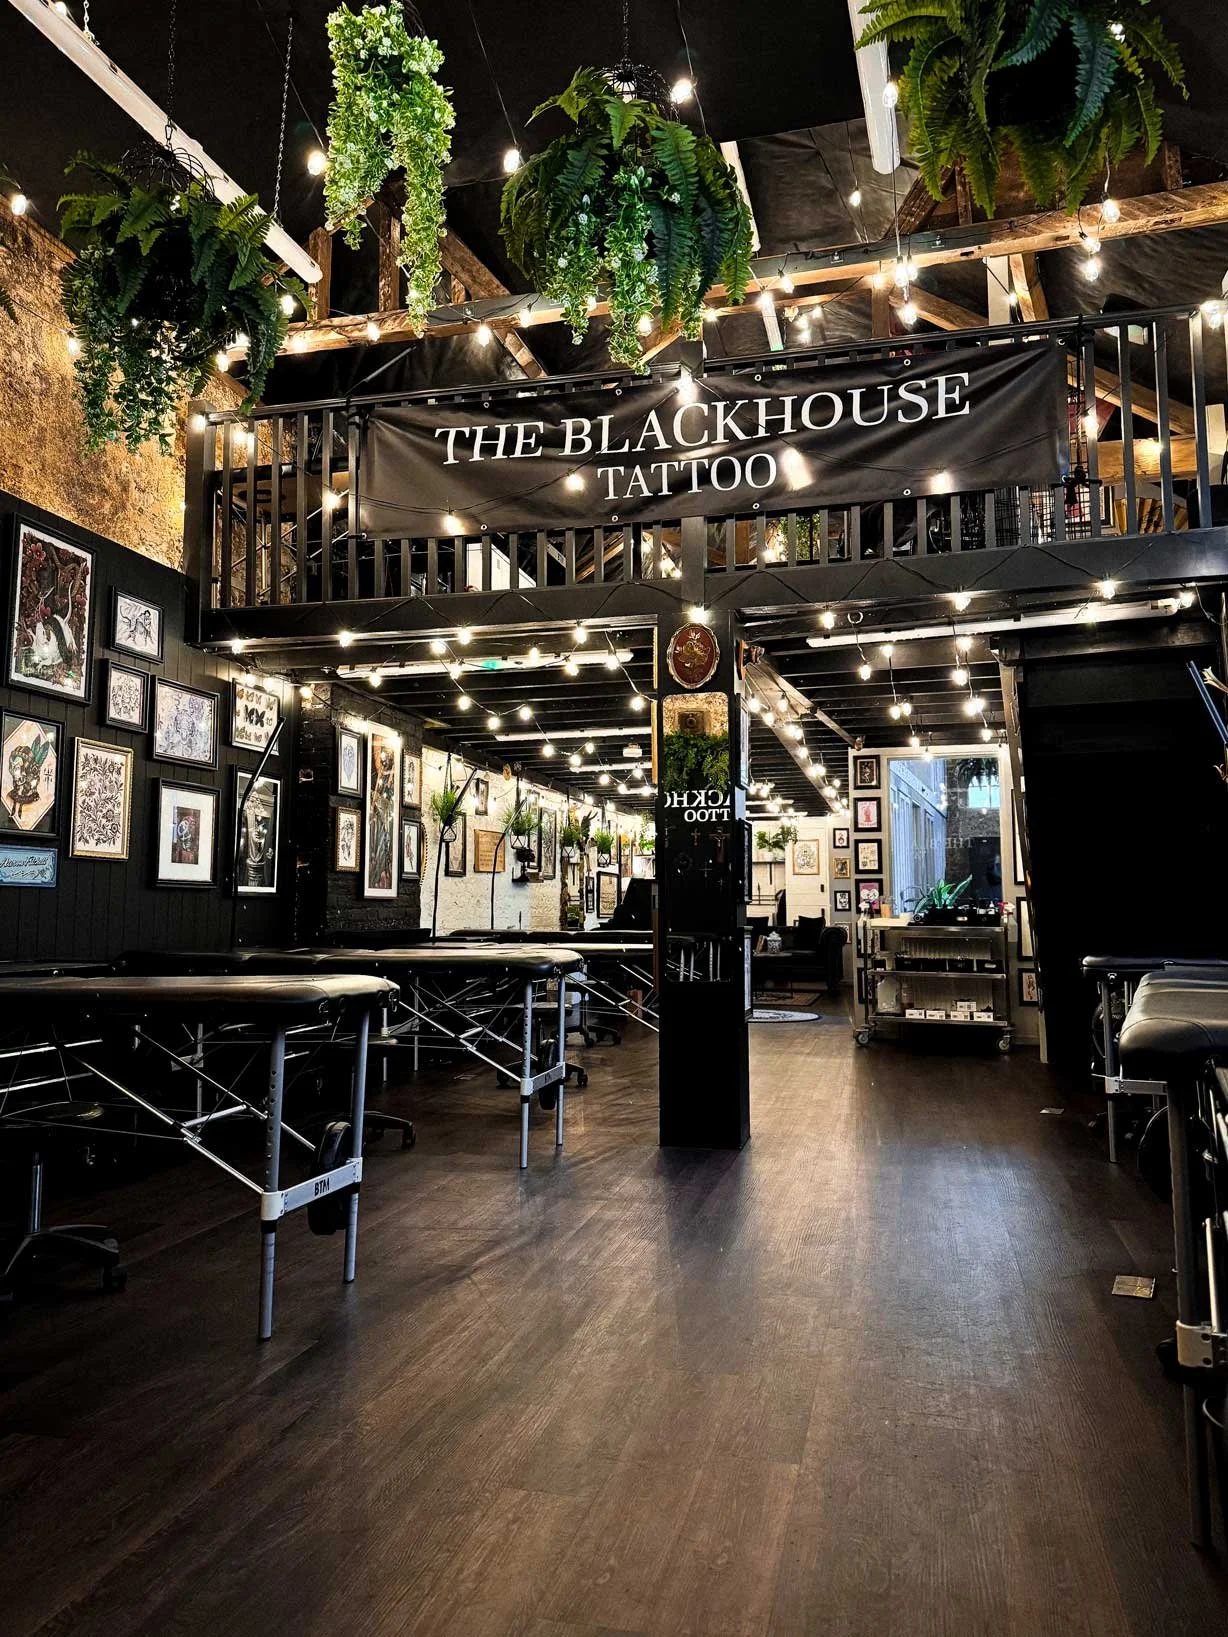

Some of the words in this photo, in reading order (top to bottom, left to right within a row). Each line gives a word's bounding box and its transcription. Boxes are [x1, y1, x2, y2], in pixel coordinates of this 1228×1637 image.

[434, 422, 544, 464] THE
[562, 372, 972, 456] BLACKHOUSE
[597, 454, 778, 499] TATTOO
[315, 1178, 329, 1196] BTM
